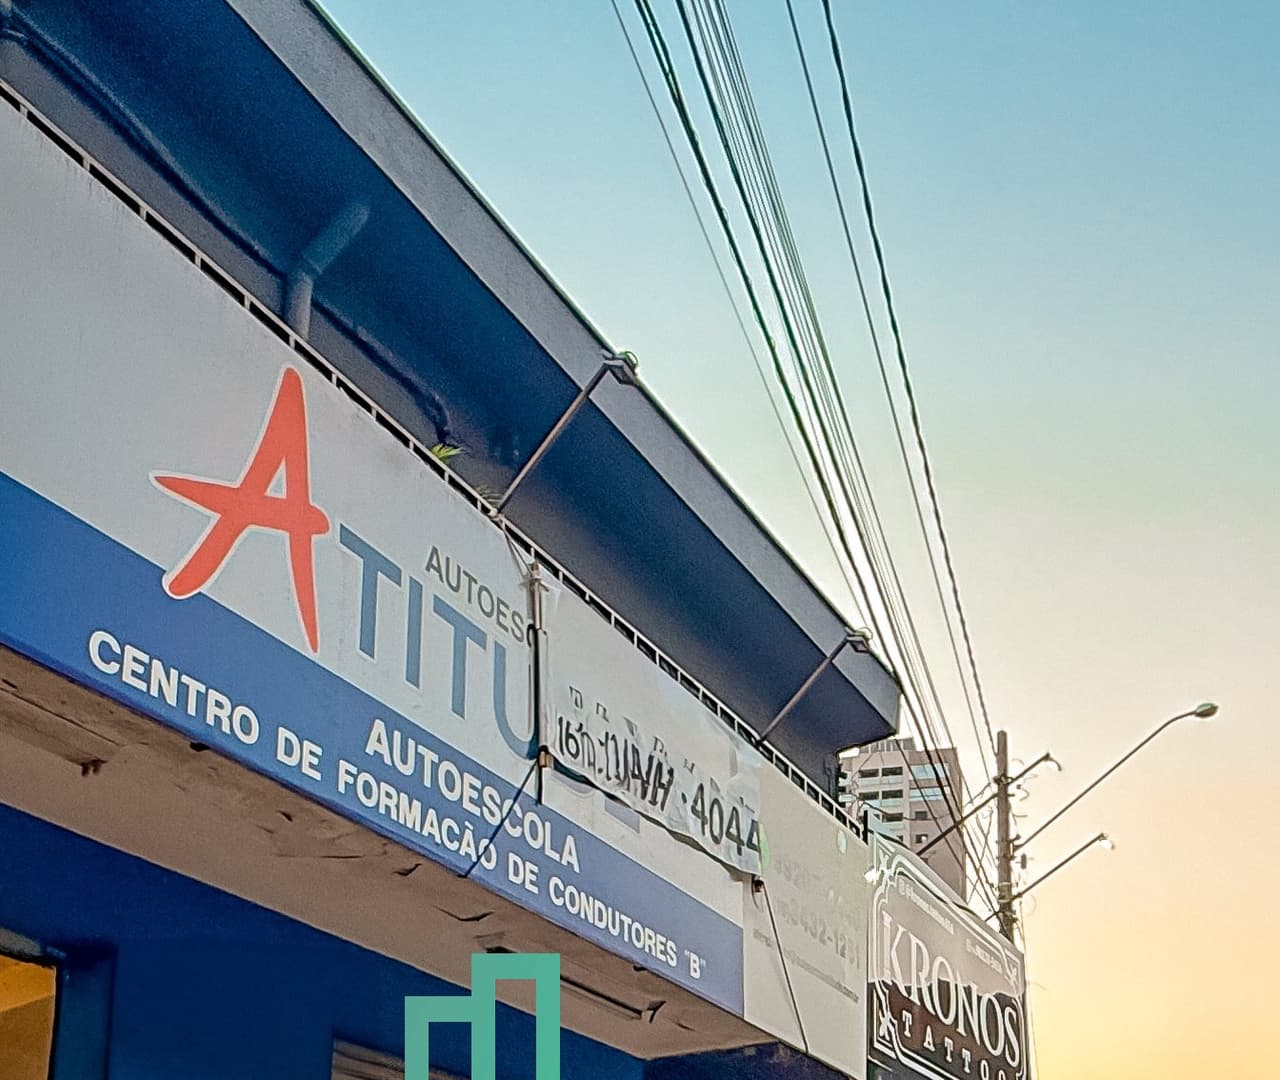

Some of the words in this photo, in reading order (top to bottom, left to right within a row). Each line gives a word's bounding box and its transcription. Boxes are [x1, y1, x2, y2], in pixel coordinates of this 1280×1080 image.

[425, 544, 538, 649] AUTOES
[89, 630, 260, 745] CENTRO
[276, 726, 323, 781] DE
[508, 852, 539, 895] DE
[548, 876, 678, 968] CONDUTORES
[684, 949, 706, 979] "B"
[365, 718, 581, 874] AUTOESCOLA
[882, 910, 1020, 1069] KRONOS
